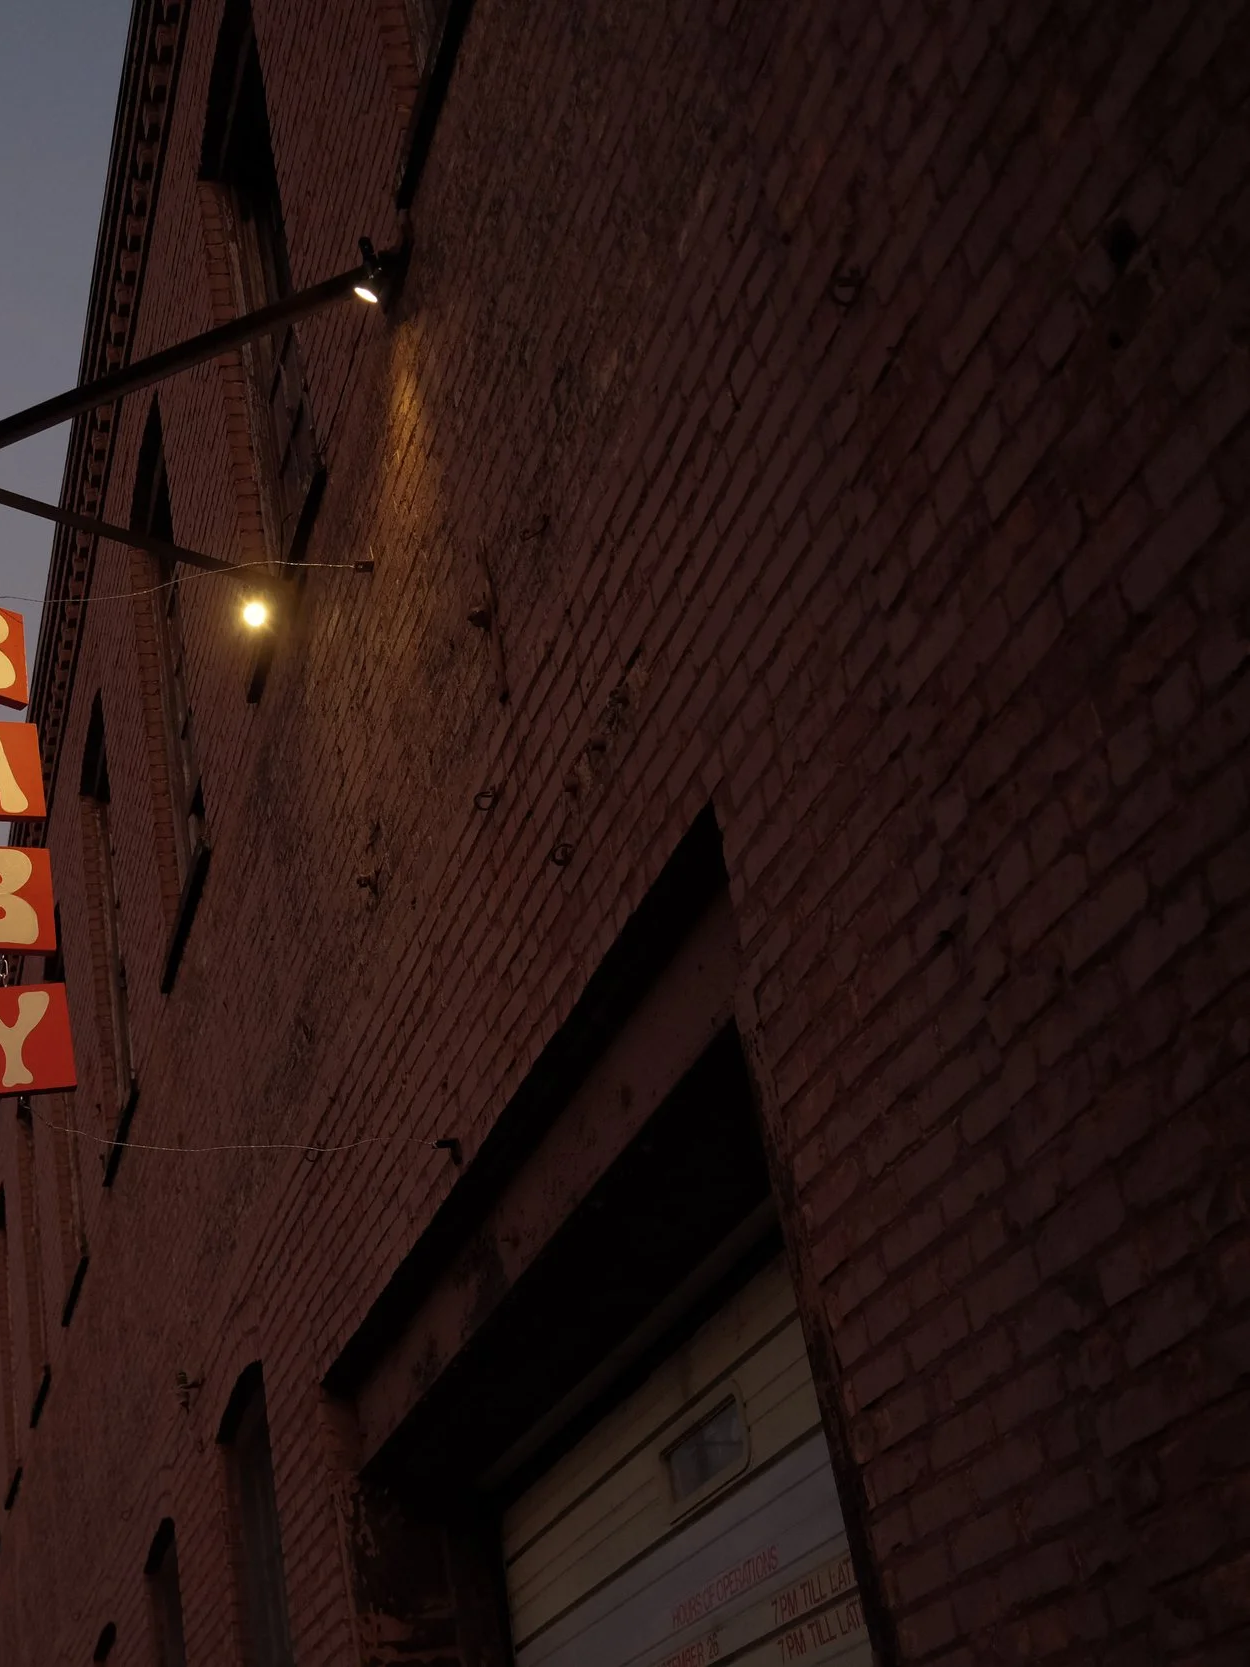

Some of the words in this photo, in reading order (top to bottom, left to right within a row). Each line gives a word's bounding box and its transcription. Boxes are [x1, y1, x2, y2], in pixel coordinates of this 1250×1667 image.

[672, 1593, 702, 1630] HOURS
[702, 1582, 716, 1611] OF
[716, 1545, 779, 1602] OPERATIONS
[800, 1573, 828, 1610] TILL
[829, 1557, 853, 1595] LAT
[807, 1615, 838, 1649] TILL
[835, 1600, 863, 1636] LAT
